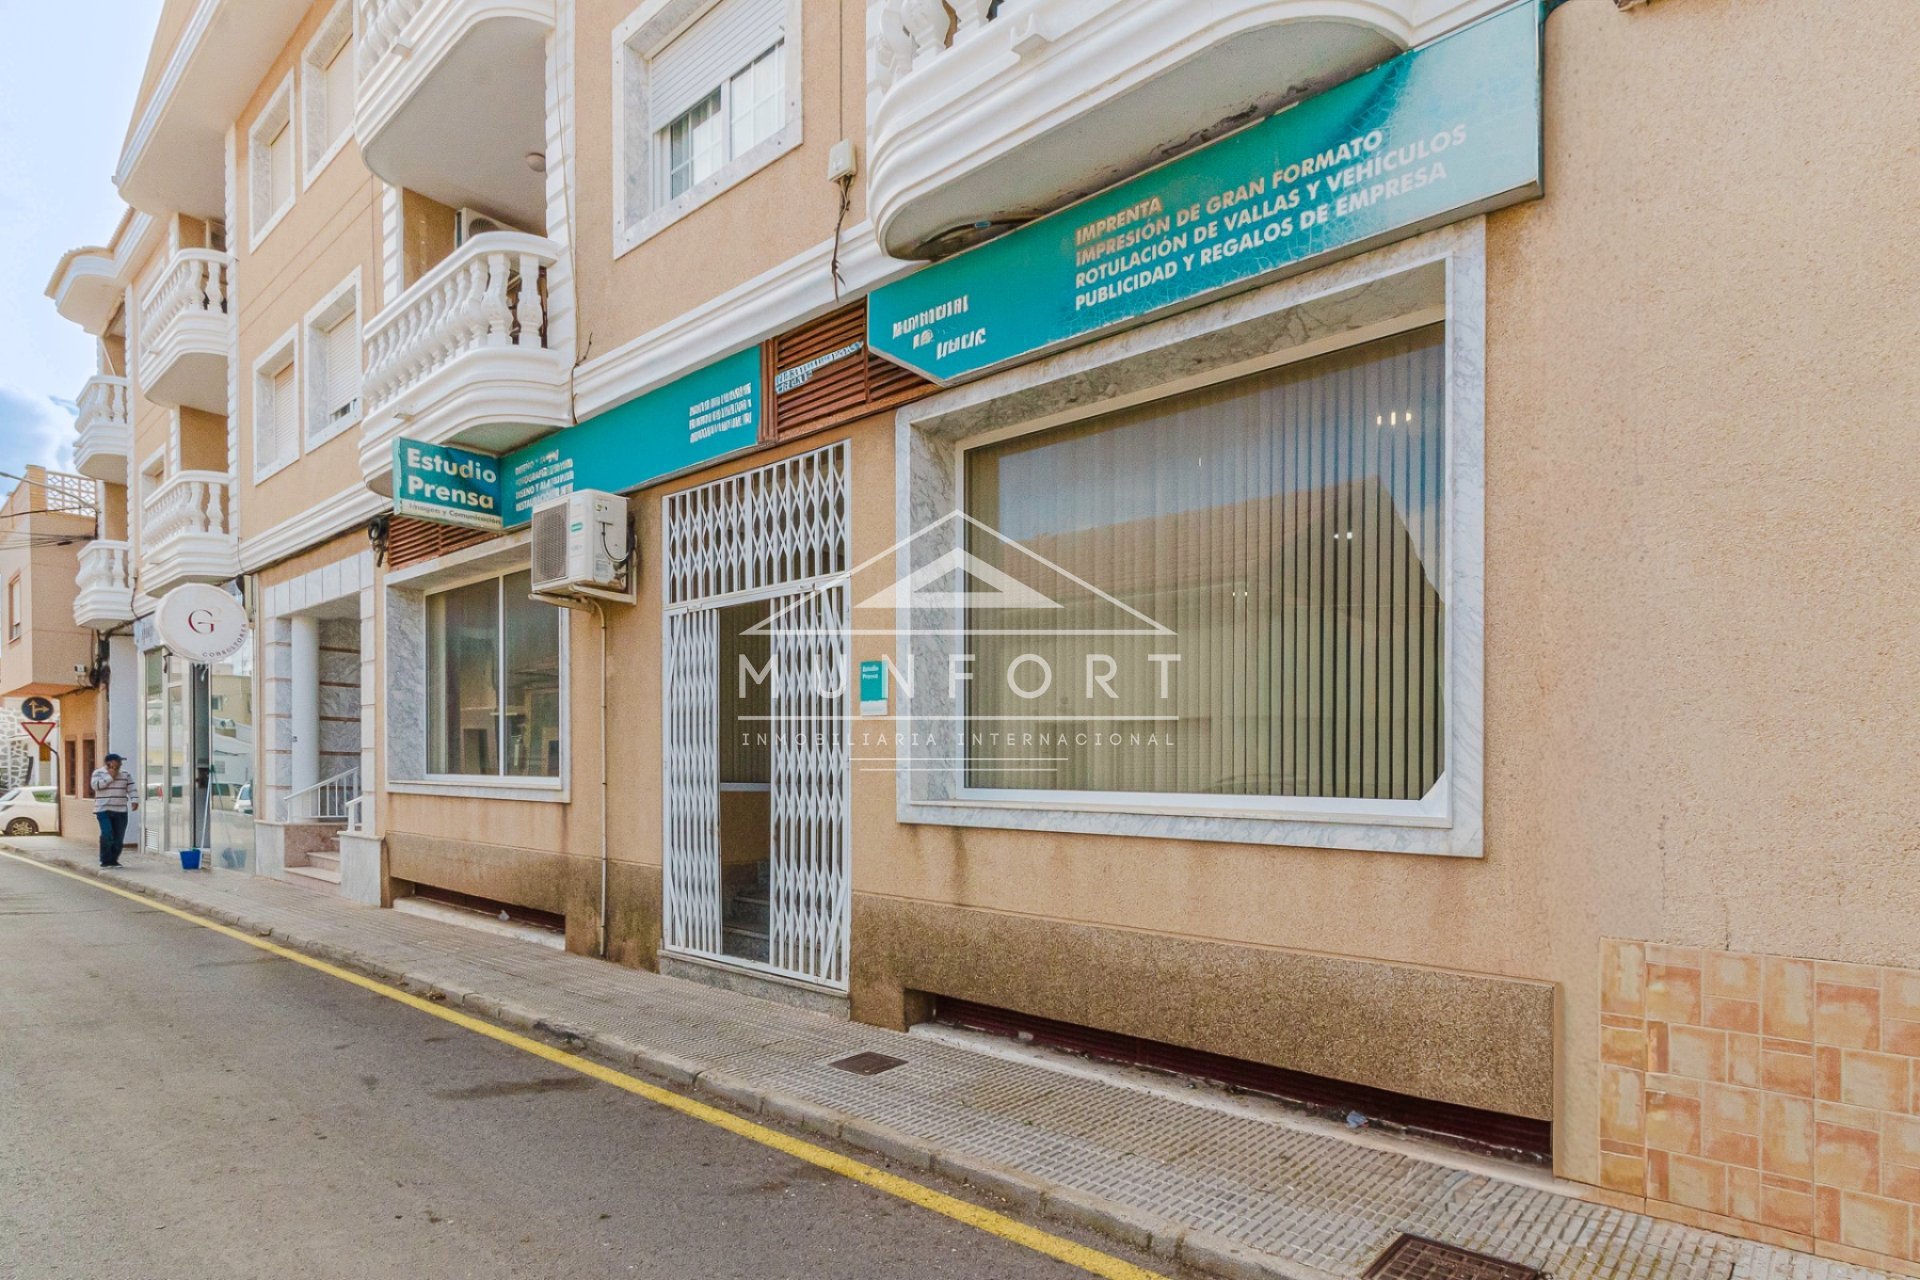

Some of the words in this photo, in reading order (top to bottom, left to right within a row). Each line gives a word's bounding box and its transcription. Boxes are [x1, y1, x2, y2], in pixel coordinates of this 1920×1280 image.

[1075, 216, 1170, 267] IMPRESIÓN
[1176, 203, 1200, 227] DE
[1206, 177, 1265, 215] GRAN
[1272, 130, 1383, 189] FORMATO
[1075, 232, 1187, 289] ROTULACIÓN
[1193, 221, 1218, 245] DE
[1223, 188, 1300, 232] VALLAS
[1306, 179, 1320, 201] Y
[1326, 124, 1466, 192] VEHÍCULOS
[1075, 196, 1163, 246] IMPRENTA
[1075, 261, 1178, 311] PUBLICIDAD
[1182, 253, 1195, 272] Y
[1200, 217, 1293, 266] REGALOS
[1300, 203, 1329, 231] DE
[1335, 161, 1447, 217] EMPRESA
[406, 447, 497, 483] Estudio
[407, 475, 494, 509] Prensa
